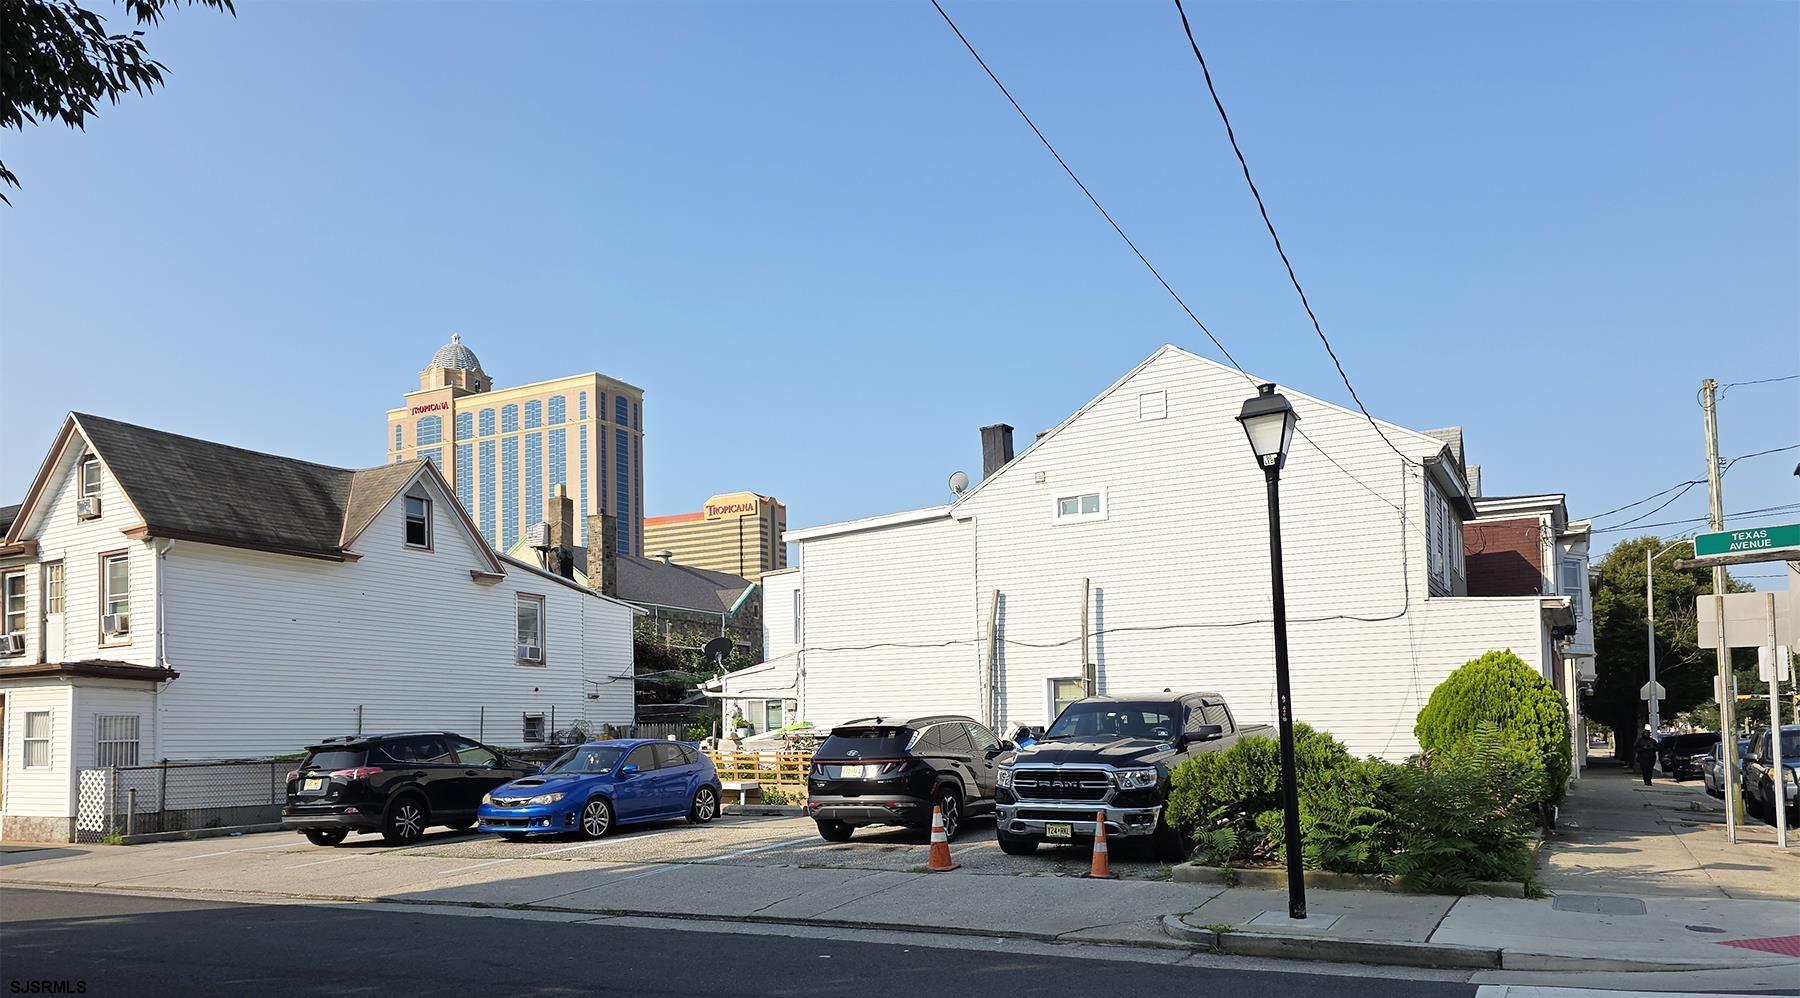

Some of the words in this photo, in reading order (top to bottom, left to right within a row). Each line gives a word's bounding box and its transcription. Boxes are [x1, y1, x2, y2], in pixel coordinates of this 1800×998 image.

[706, 503, 754, 516] TROPICANA
[1732, 530, 1767, 541] TEXAS
[1729, 539, 1772, 551] AVENUE
[1038, 780, 1078, 788] RAM
